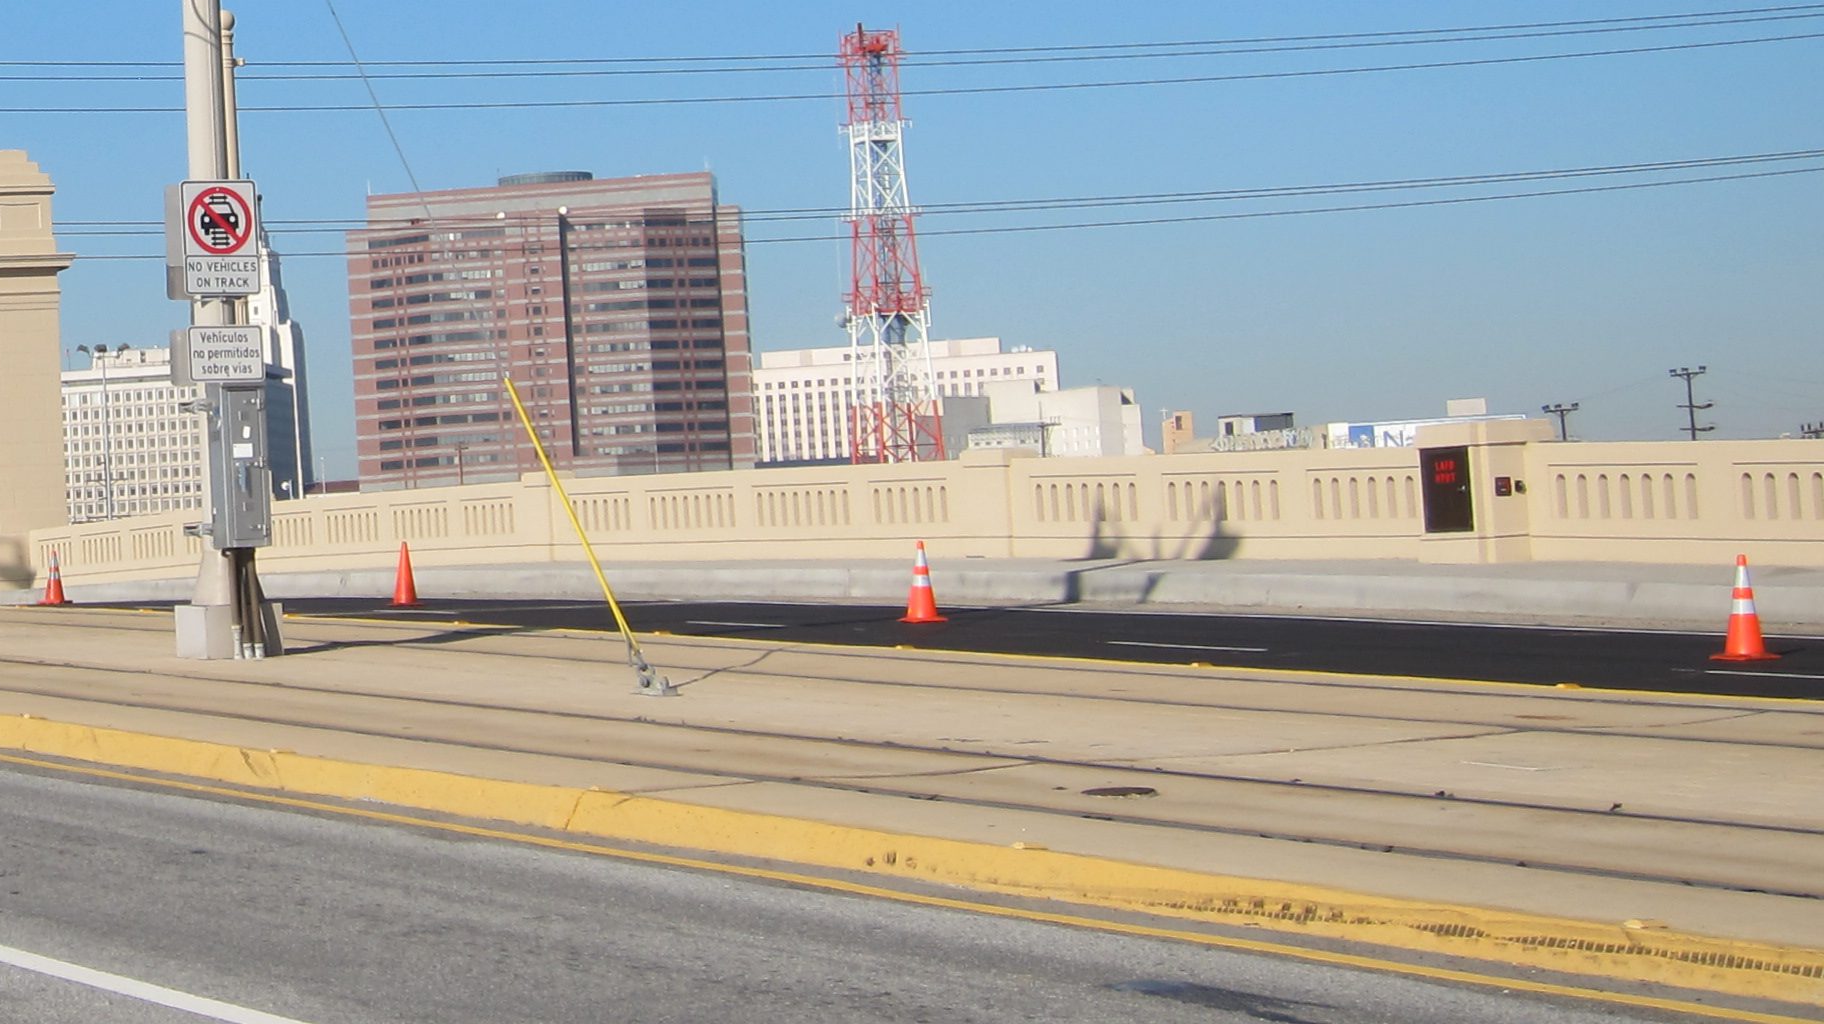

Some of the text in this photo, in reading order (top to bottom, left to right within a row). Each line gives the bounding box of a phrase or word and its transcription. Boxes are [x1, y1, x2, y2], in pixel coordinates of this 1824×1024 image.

[188, 261, 257, 272] NO VEHICLES
[196, 277, 250, 288] ON TRACK
[200, 331, 249, 343] Vehículos
[193, 347, 260, 362] no permitidos
[201, 362, 253, 375] sobre vías
